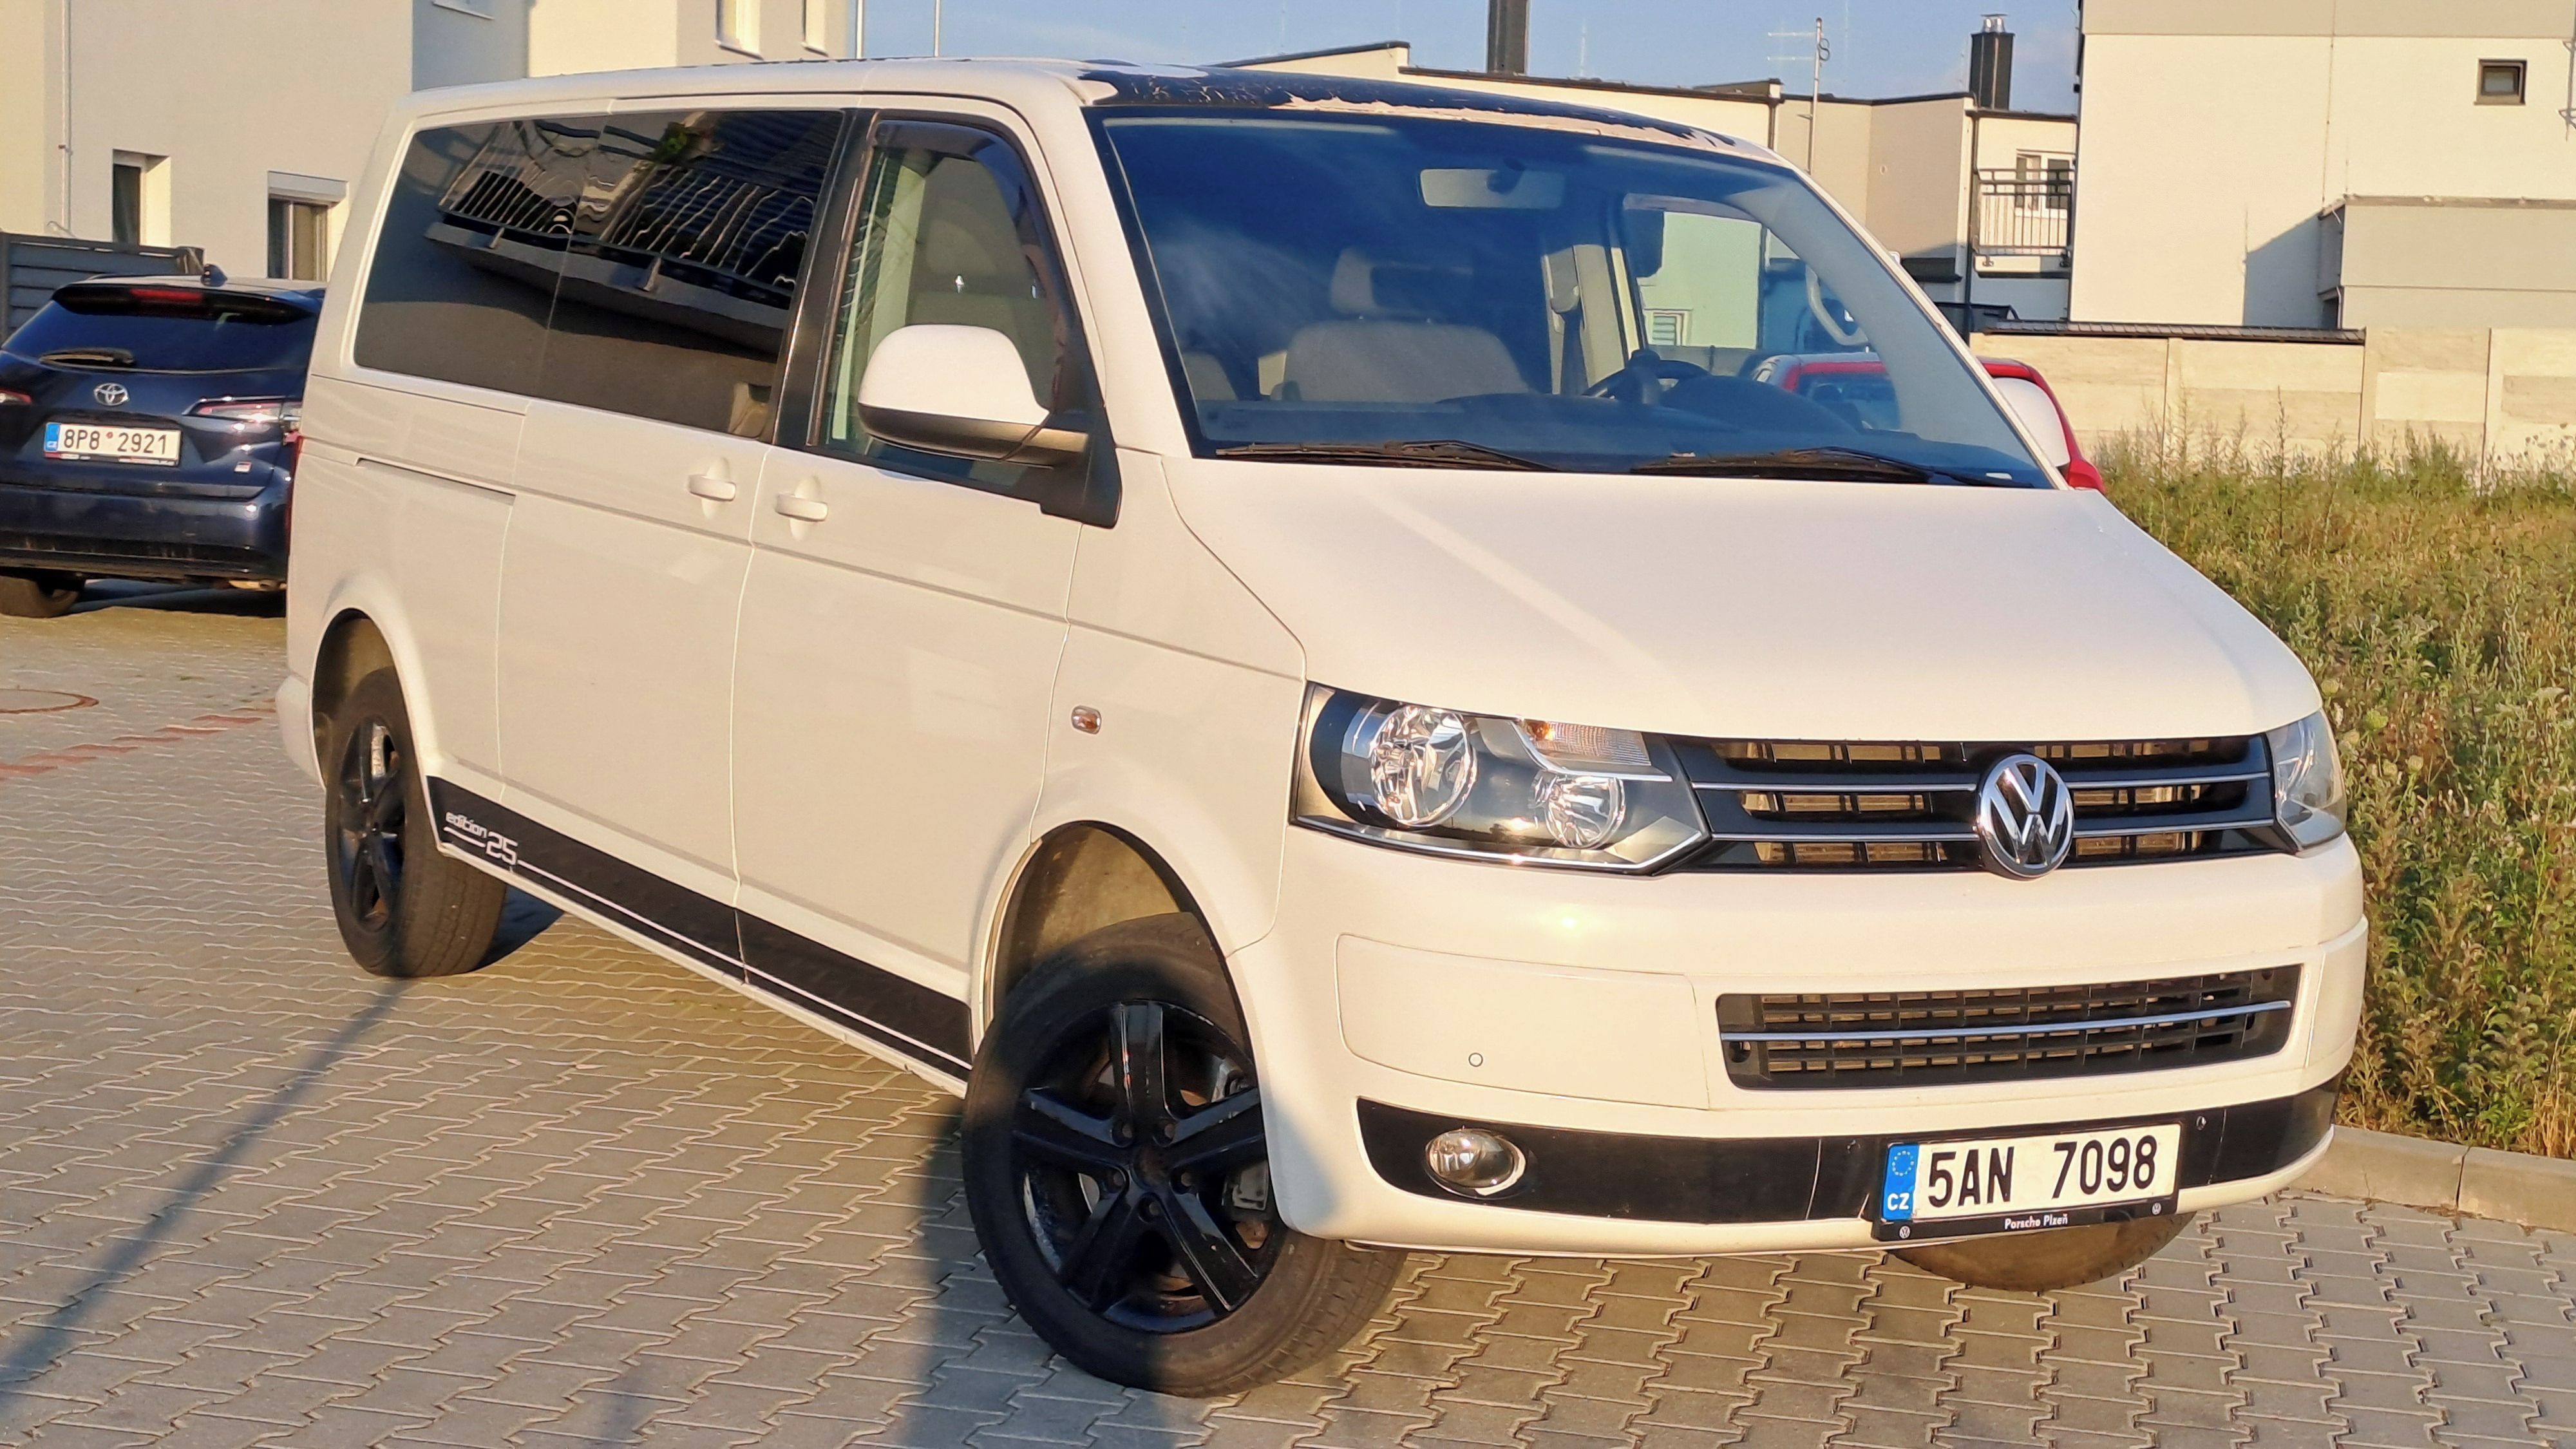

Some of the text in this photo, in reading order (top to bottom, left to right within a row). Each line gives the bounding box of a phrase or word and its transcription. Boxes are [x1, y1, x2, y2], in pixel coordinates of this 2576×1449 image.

[64, 429, 167, 455] 8P8 2921
[445, 811, 518, 866] edition 25
[1980, 753, 2074, 878] VW
[1927, 1134, 2158, 1208] 5AN 7098
[1887, 1193, 1910, 1210] CZ
